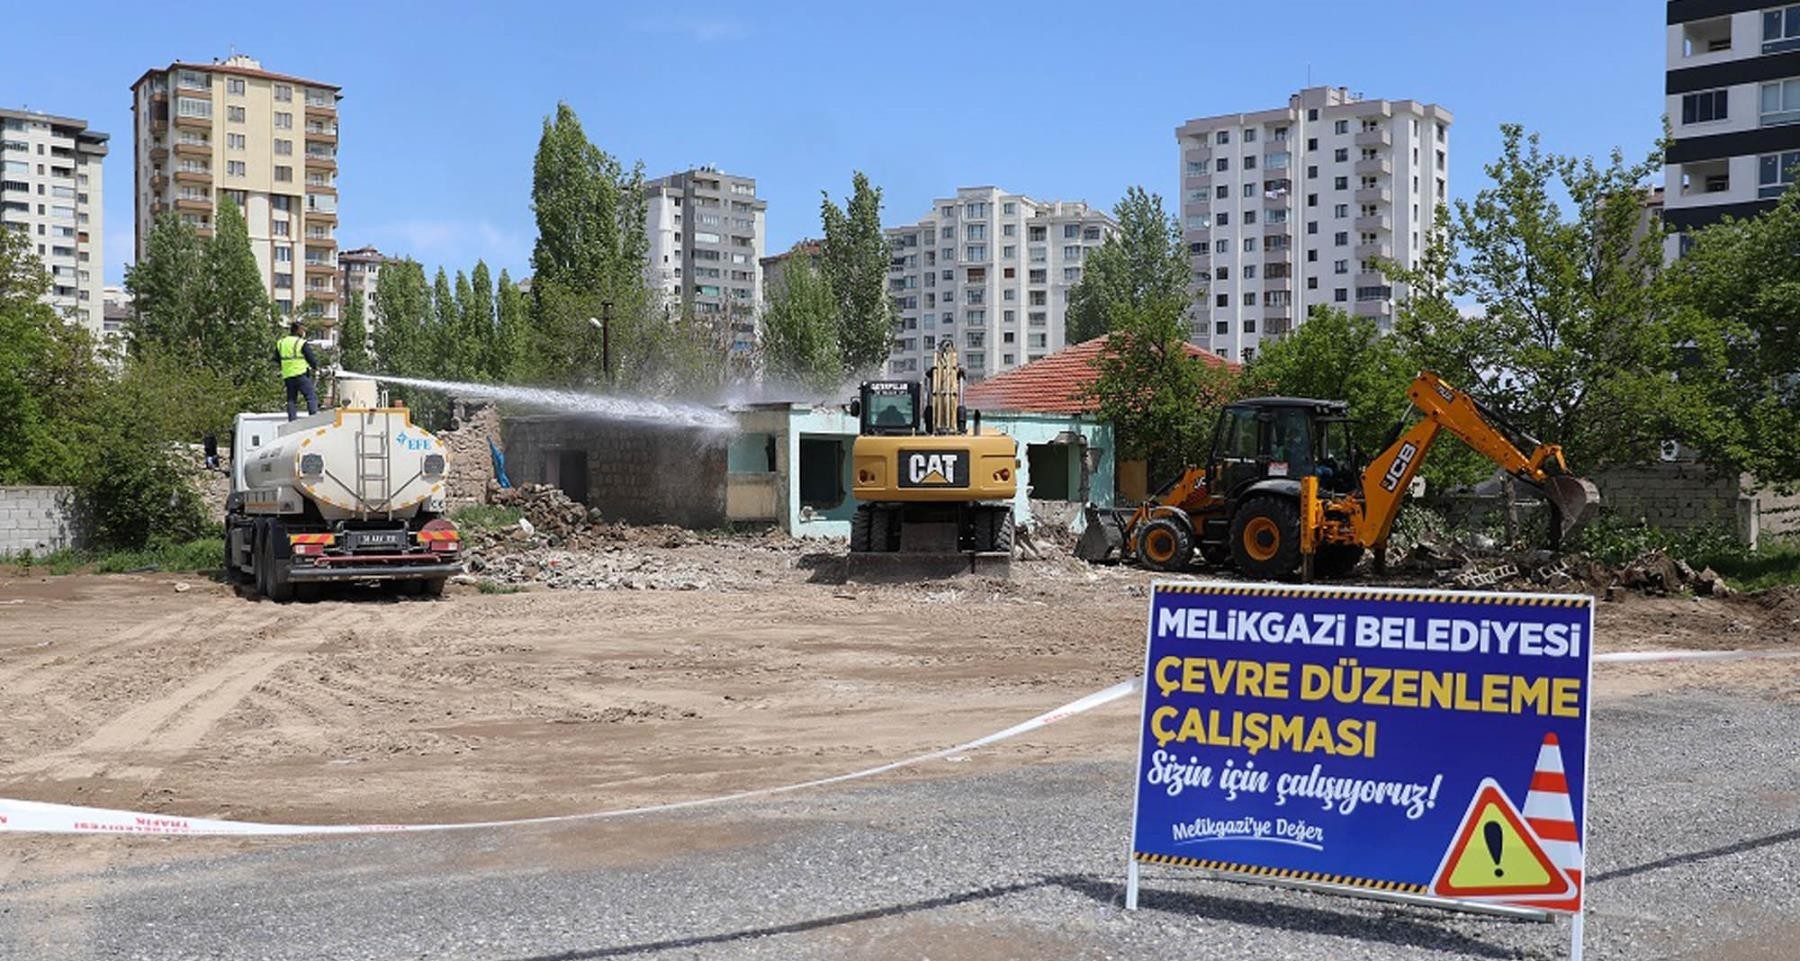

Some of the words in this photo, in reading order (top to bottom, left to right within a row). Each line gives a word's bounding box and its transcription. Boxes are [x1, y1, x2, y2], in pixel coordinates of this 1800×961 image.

[408, 439, 431, 450] EFE
[910, 454, 957, 483] CAT
[1387, 443, 1417, 491] JCB
[1155, 656, 1290, 698] ÇEVRE
[1301, 658, 1581, 717] DÜZENLEME
[1151, 706, 1377, 758] ÇALIŞMASI
[1147, 749, 1213, 796] Sizin
[1219, 759, 1271, 801] için
[1275, 764, 1443, 820] çalışıyoruz!
[1173, 817, 1272, 840] Melikgazi'ye
[1276, 819, 1324, 842] Değer
